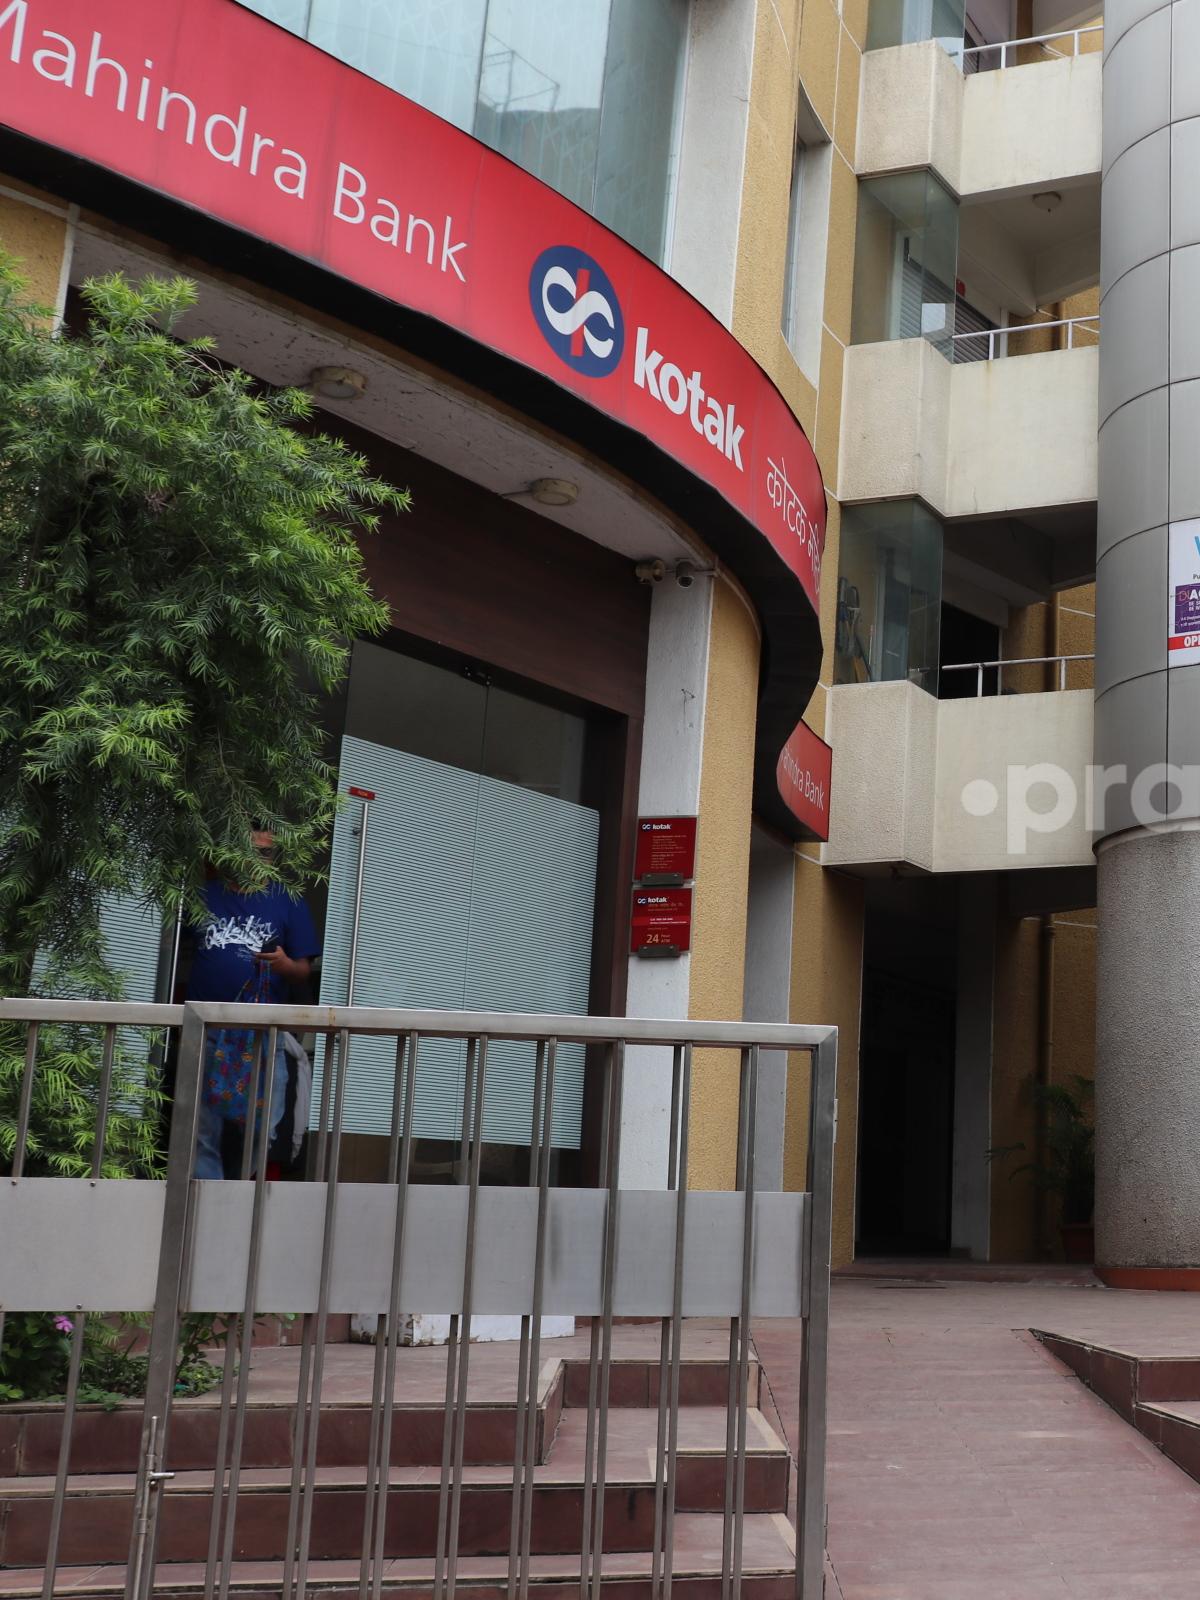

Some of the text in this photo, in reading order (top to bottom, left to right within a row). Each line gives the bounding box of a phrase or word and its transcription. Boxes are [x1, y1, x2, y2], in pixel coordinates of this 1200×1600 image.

[332, 161, 468, 283] Bank
[633, 326, 745, 473] kotak
[766, 456, 807, 546] कोटक
[804, 770, 825, 811] Bank
[646, 934, 659, 943] 24
